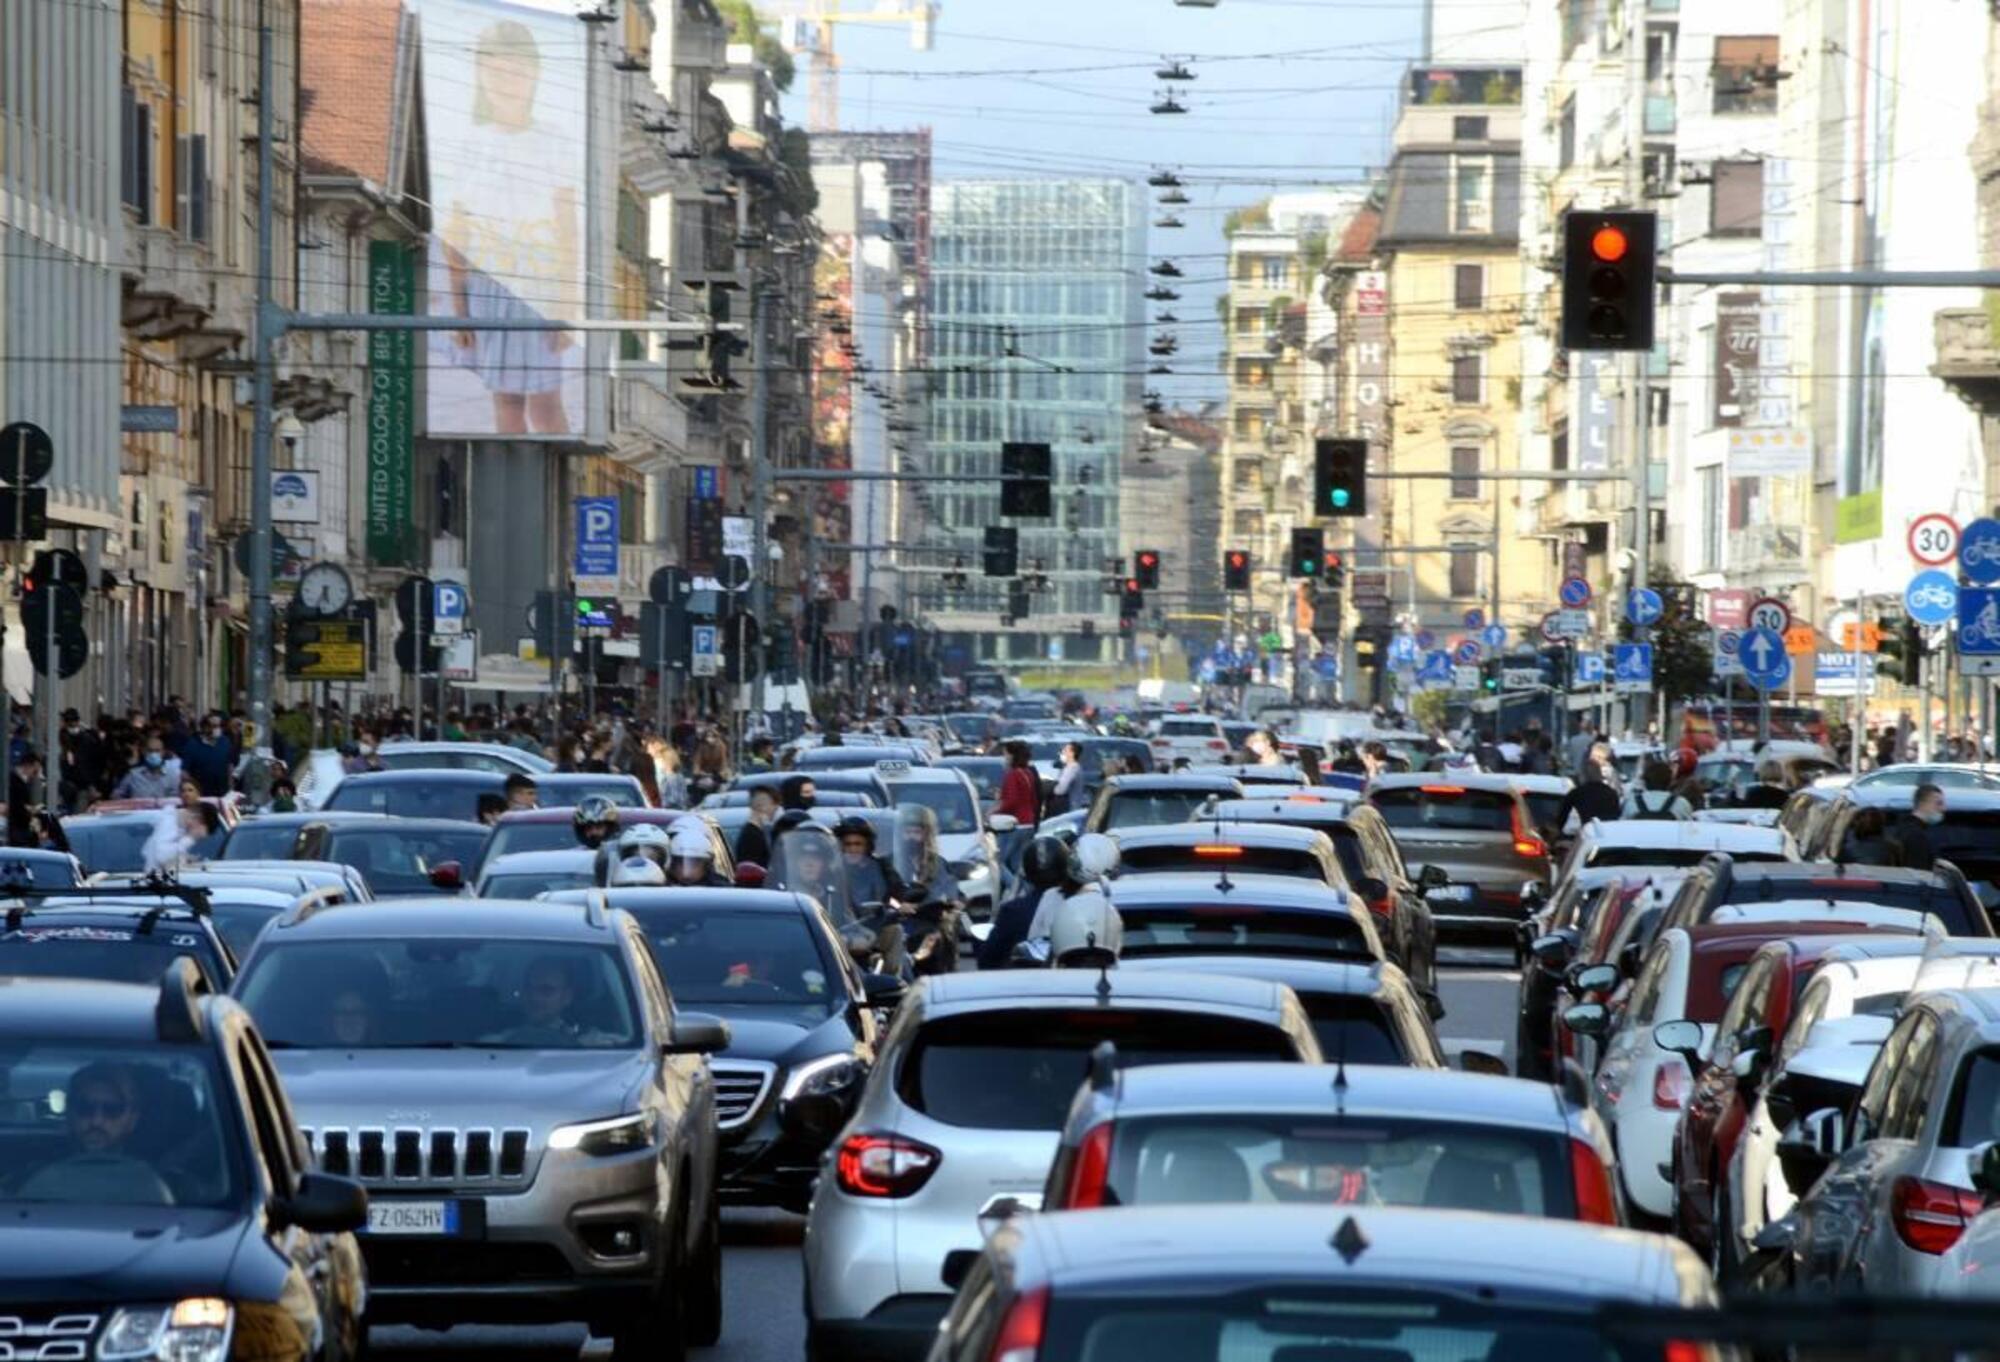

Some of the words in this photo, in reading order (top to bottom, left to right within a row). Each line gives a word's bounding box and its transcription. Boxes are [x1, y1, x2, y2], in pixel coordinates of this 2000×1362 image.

[374, 262, 391, 361] BENTTON.
[375, 368, 391, 389] OF
[1589, 359, 1609, 448] TEL
[373, 395, 390, 466] COLORS
[373, 471, 389, 536] UNITED
[586, 509, 612, 541] P
[1918, 527, 1950, 552] 30
[439, 588, 454, 615] P
[1757, 609, 1781, 631] 30
[1584, 656, 1604, 680] P
[1817, 652, 1874, 666] MOTA
